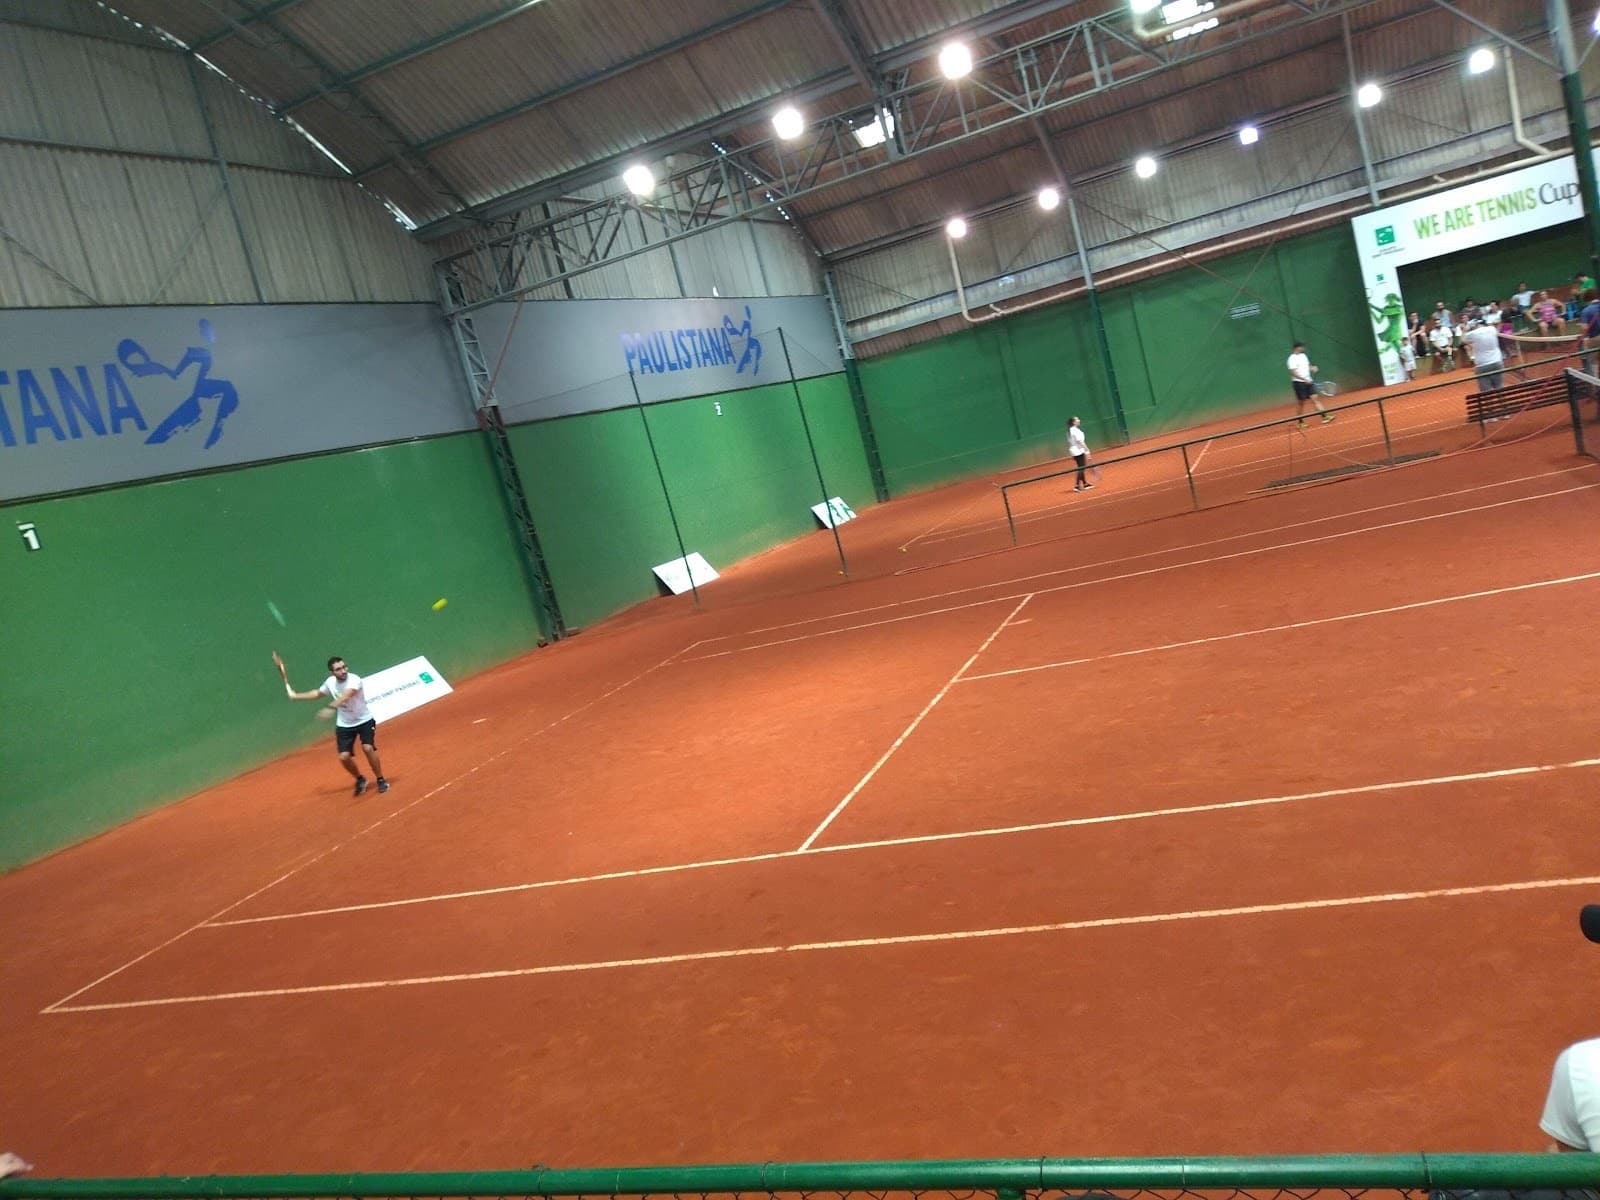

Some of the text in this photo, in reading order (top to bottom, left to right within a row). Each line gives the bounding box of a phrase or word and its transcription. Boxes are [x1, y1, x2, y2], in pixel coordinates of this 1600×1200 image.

[1413, 182, 1580, 240] WE ARE TENNIS Cup
[621, 327, 737, 376] PAULISTANA
